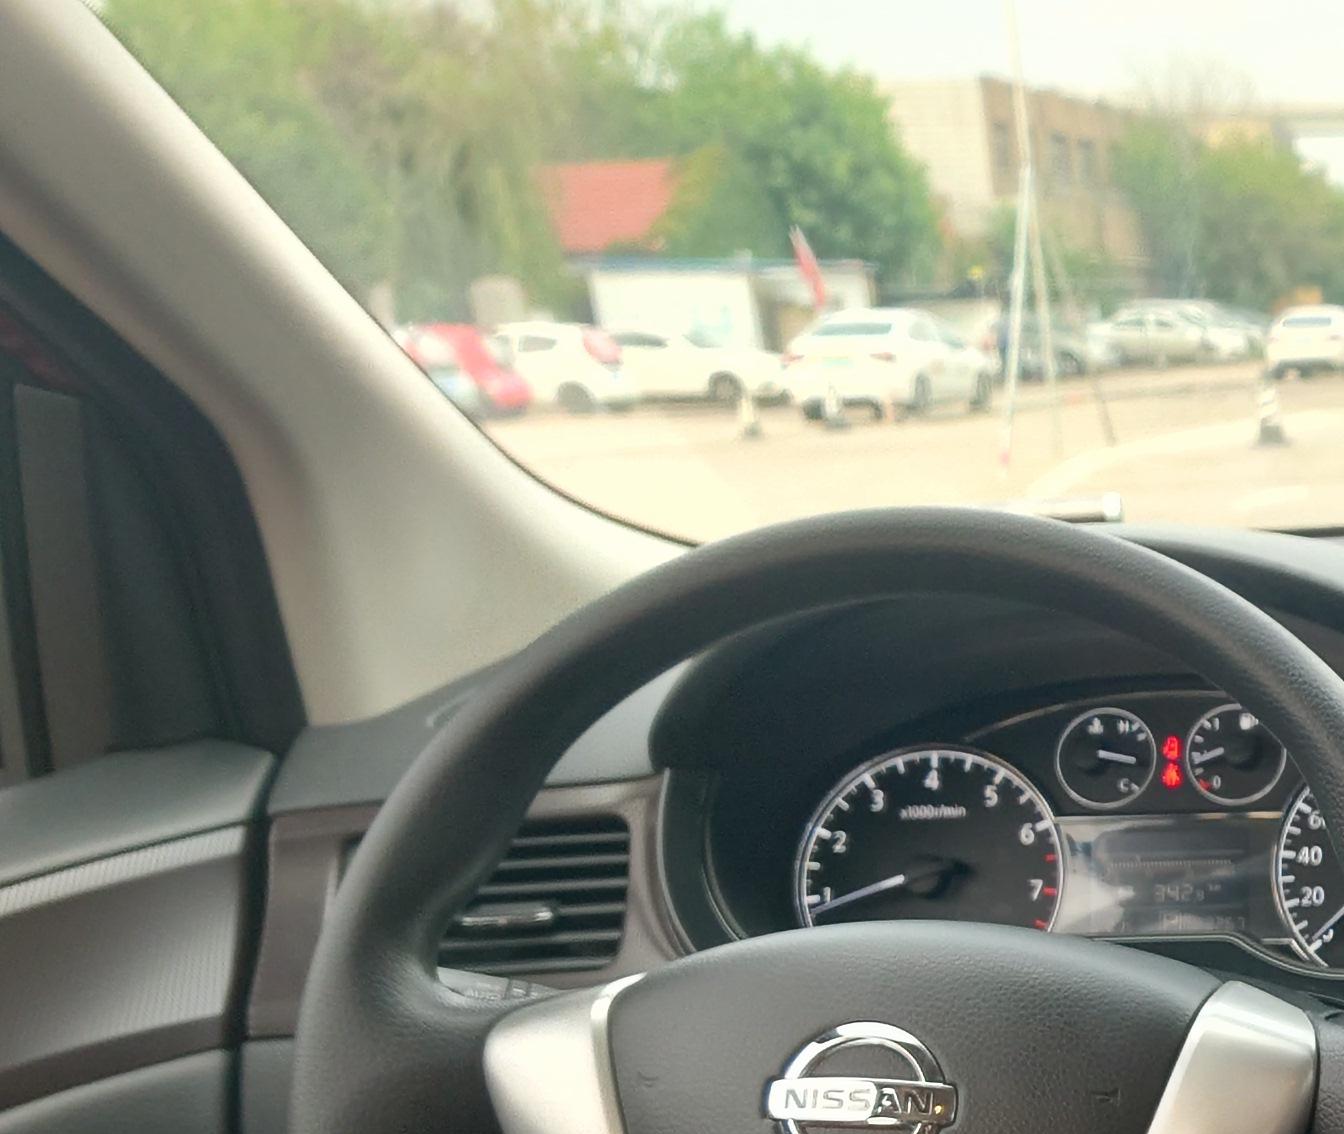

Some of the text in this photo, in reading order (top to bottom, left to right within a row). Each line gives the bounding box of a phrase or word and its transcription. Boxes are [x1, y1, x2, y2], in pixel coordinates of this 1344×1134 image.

[924, 768, 939, 791] 4
[870, 789, 884, 812] 3
[984, 784, 998, 807] 5
[1308, 810, 1326, 830] 6
[832, 830, 847, 853] 2
[1019, 822, 1035, 846] 6
[1297, 845, 1323, 867] 40
[822, 886, 832, 905] 1
[1029, 878, 1043, 901] 7
[1300, 885, 1325, 907] 20
[784, 1087, 934, 1116] NISSAN
